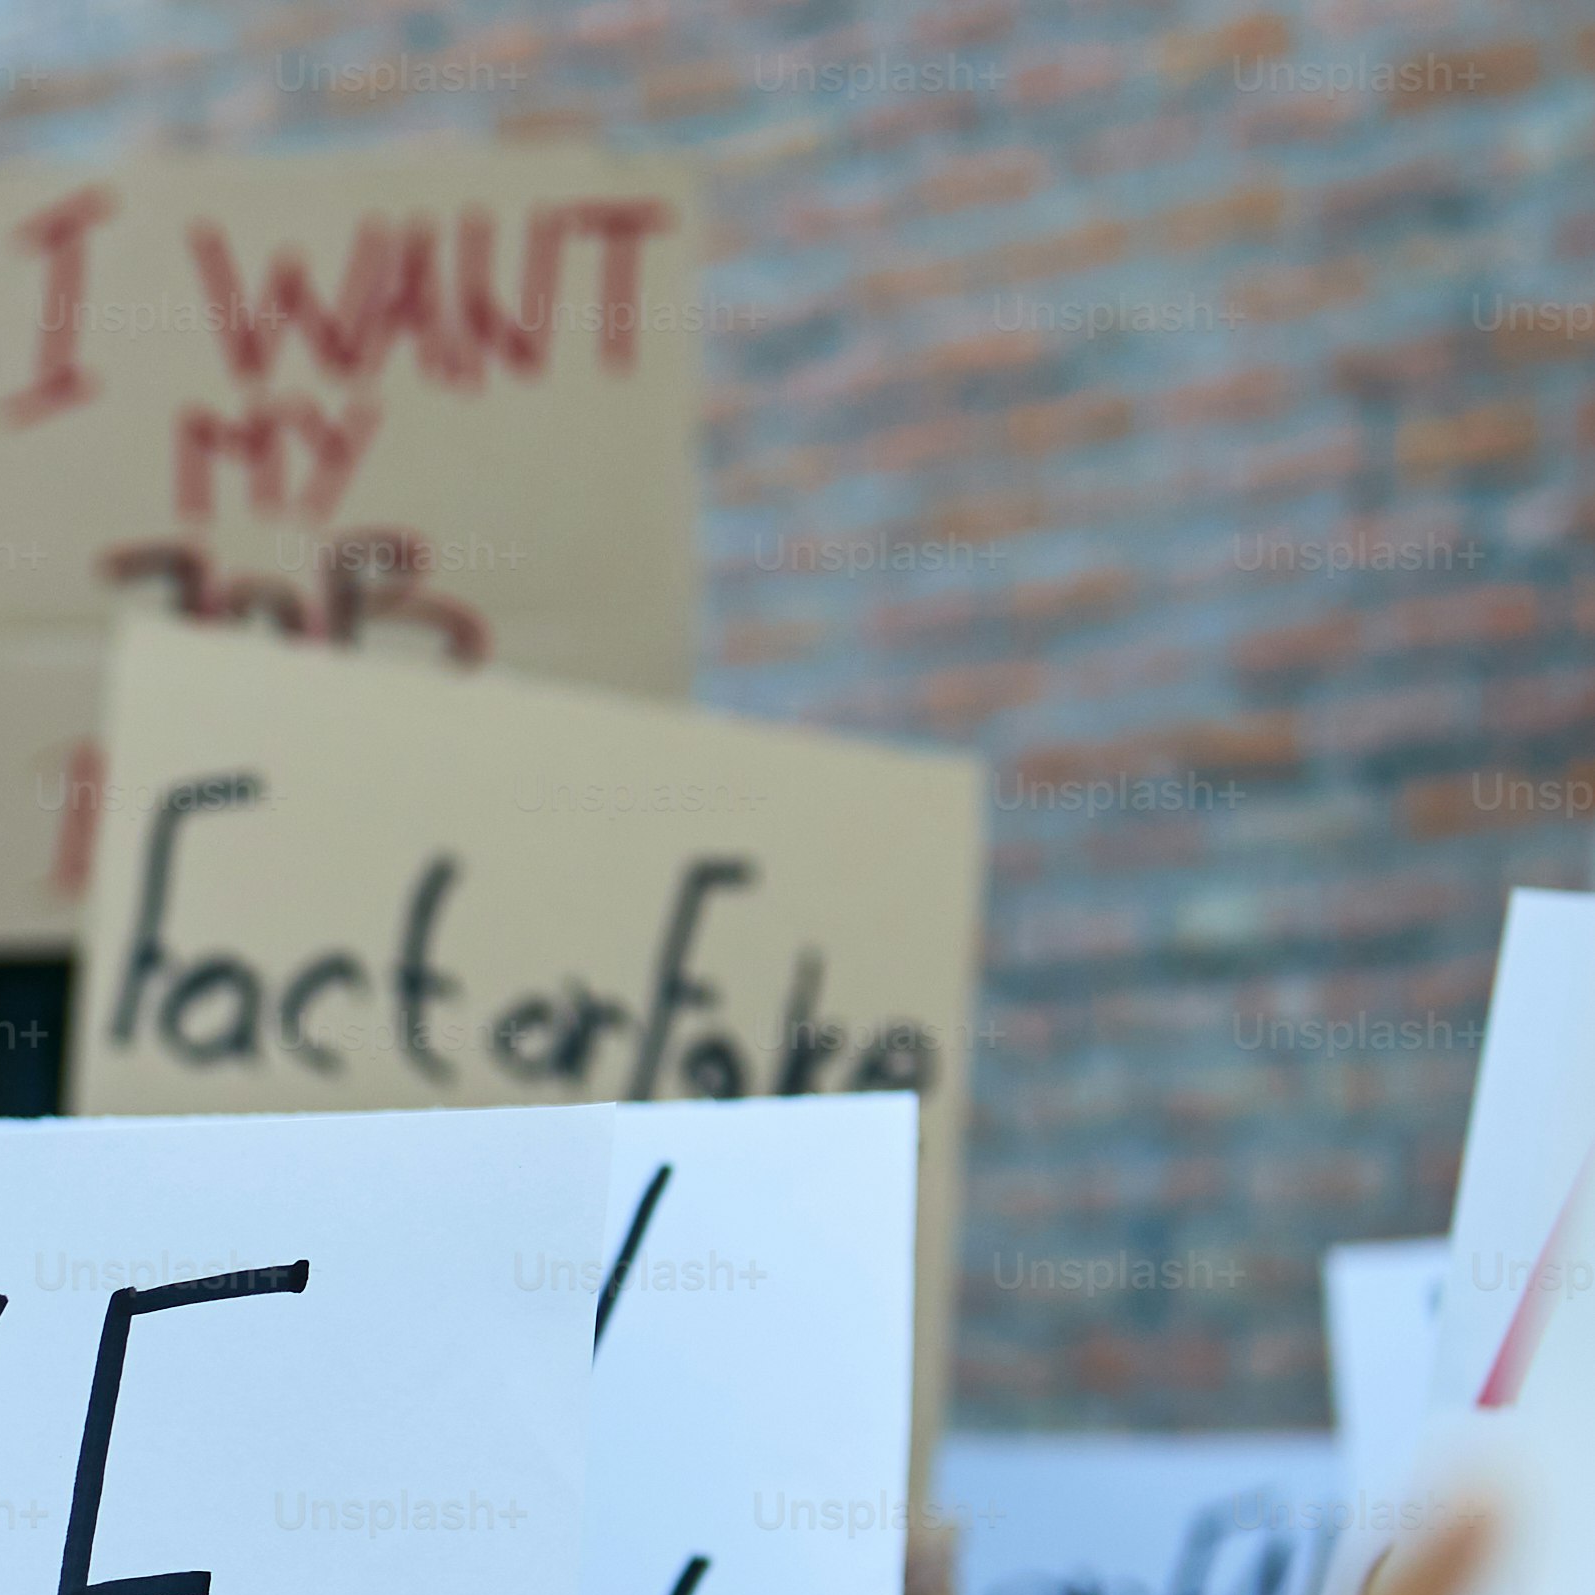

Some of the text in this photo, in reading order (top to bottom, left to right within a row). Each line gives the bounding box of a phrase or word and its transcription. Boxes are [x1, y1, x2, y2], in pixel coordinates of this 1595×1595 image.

[4, 190, 671, 425] I WANT
[174, 395, 381, 522] MY
[109, 772, 459, 1086] Fact
[489, 978, 635, 1090] or
